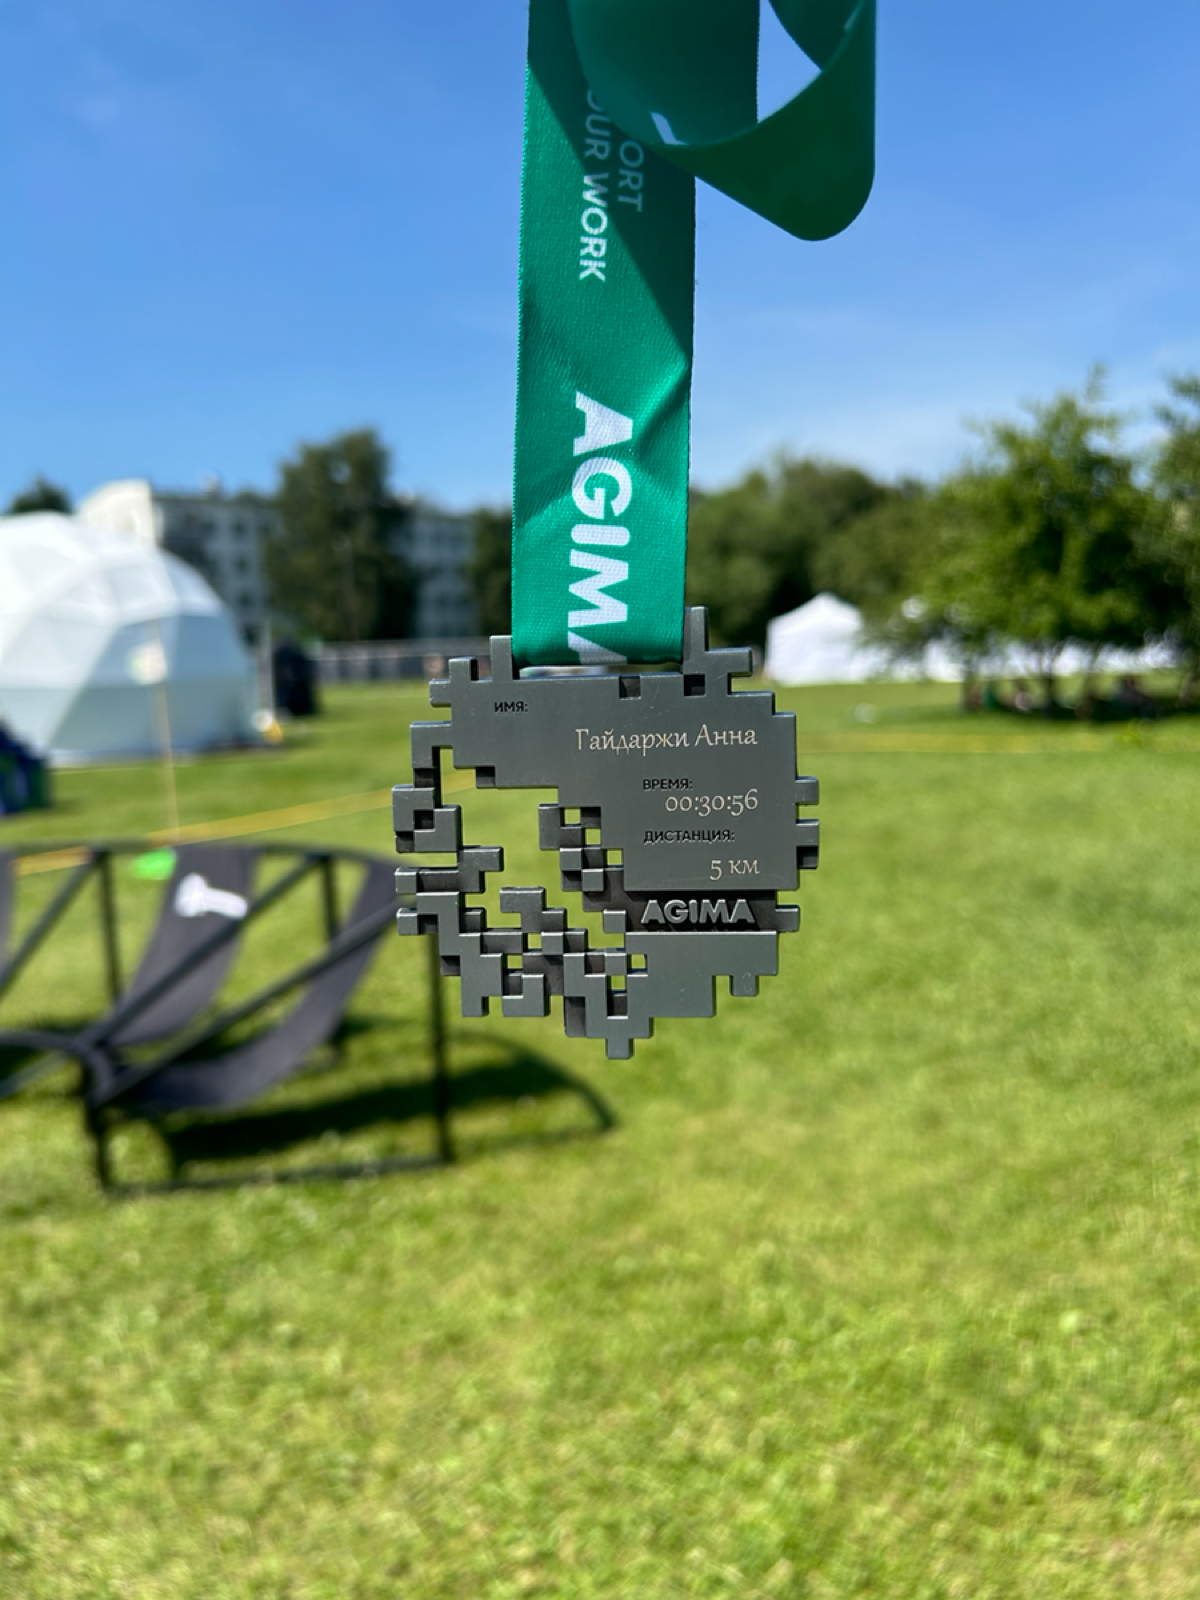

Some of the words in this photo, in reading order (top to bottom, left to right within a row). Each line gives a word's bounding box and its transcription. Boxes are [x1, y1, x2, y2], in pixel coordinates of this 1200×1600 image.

[579, 172, 609, 283] WORK
[494, 701, 529, 714] ИМЯ:
[575, 728, 690, 757] Гайдаржи
[694, 724, 759, 748] Анна
[642, 778, 694, 792] ВРЕМЯ:
[664, 788, 759, 818] 00:30:56
[643, 829, 736, 846] ДИСТАНЦИЯ:
[708, 858, 723, 882] 5
[640, 899, 756, 925] AGIMA
